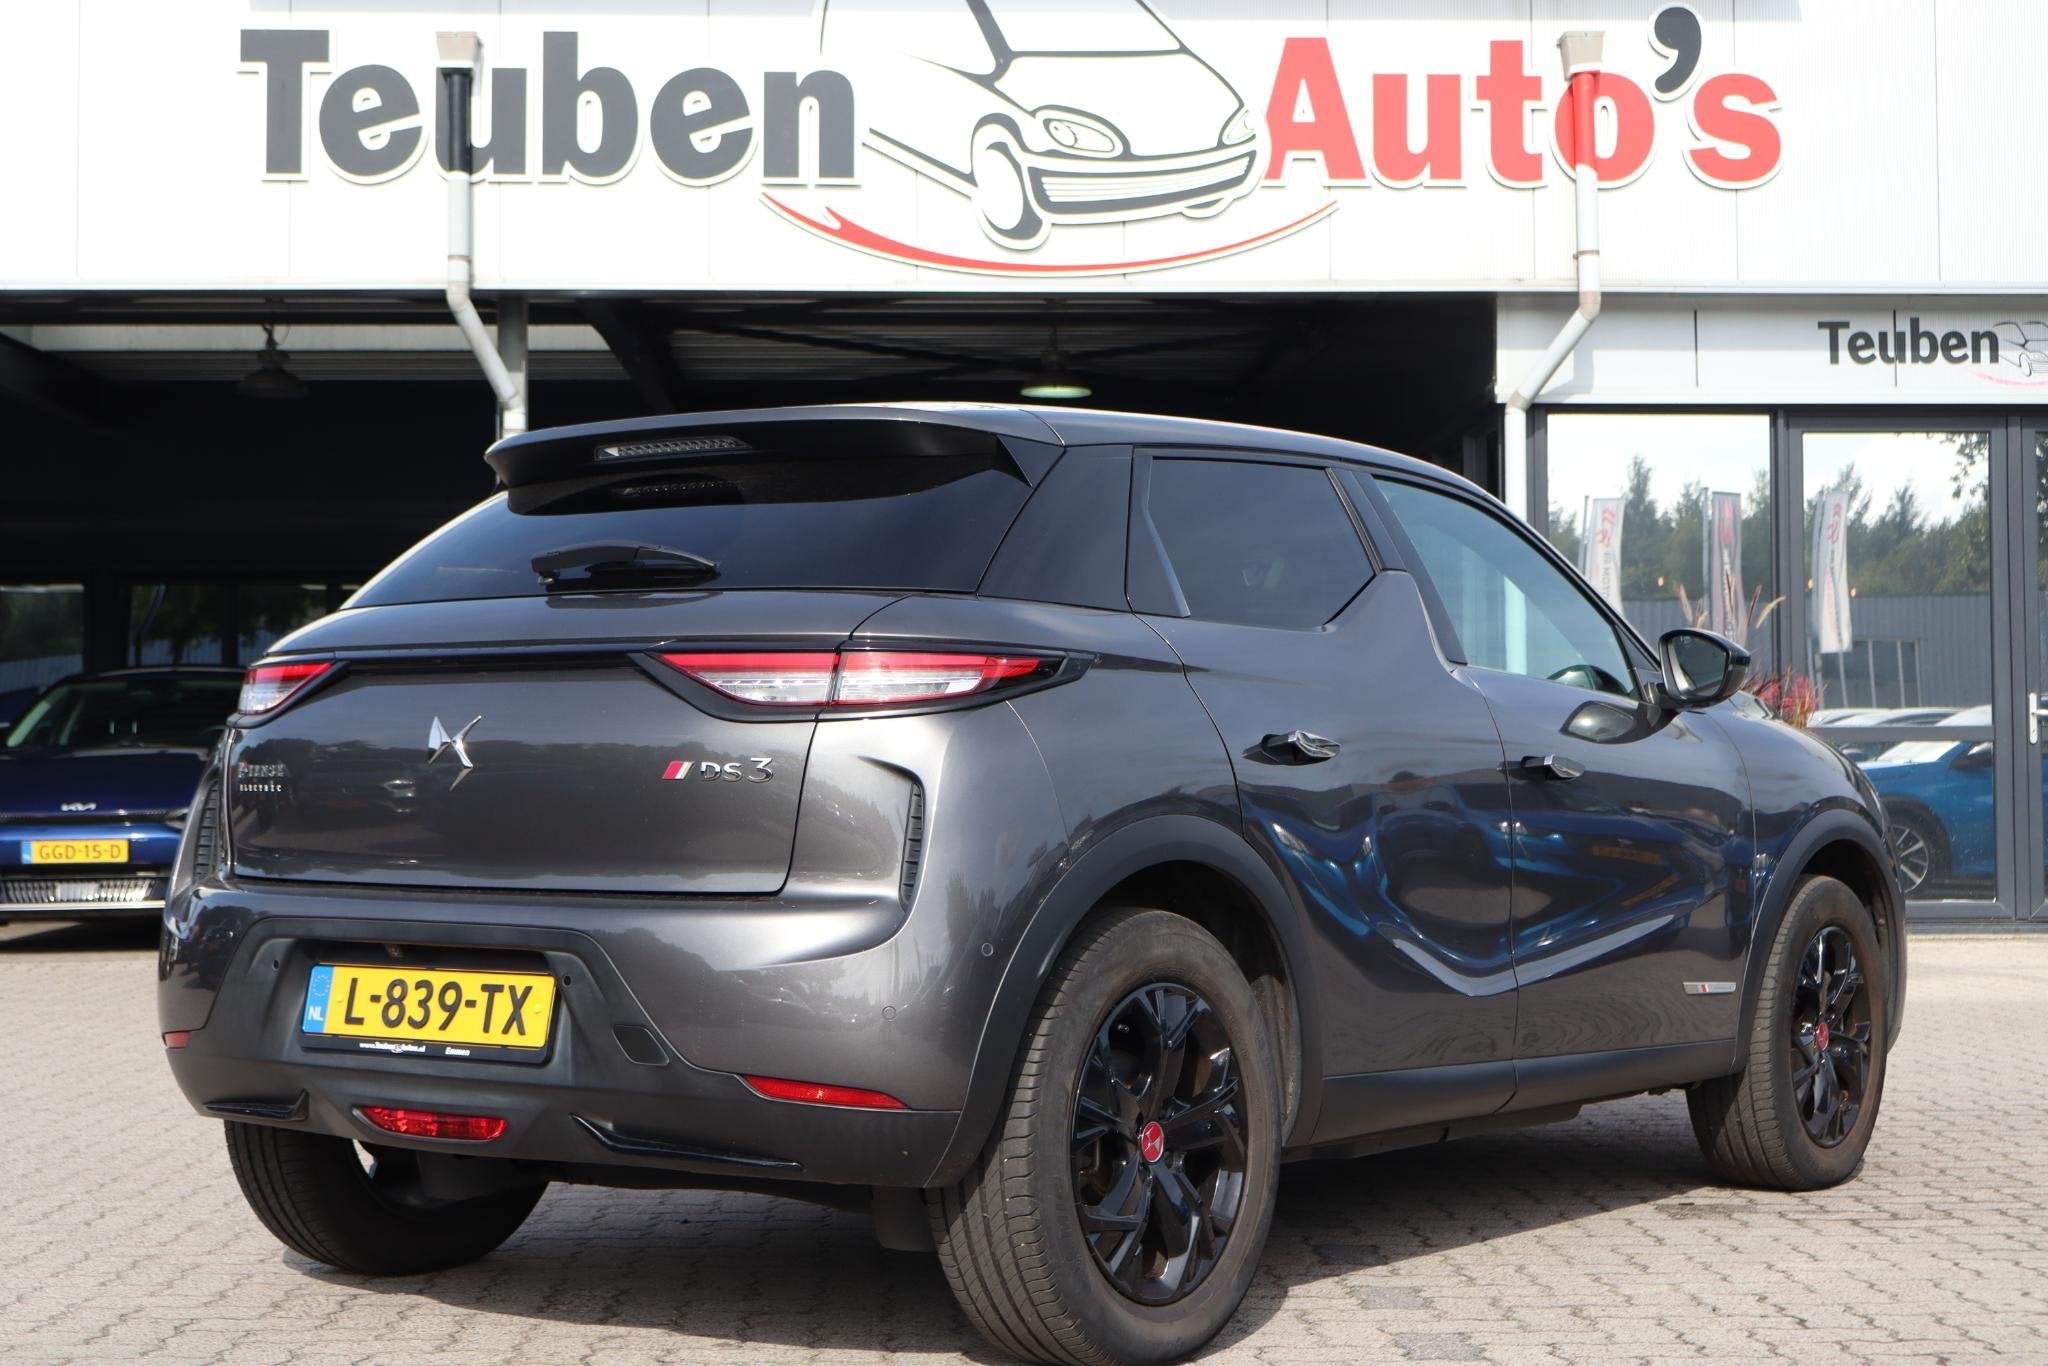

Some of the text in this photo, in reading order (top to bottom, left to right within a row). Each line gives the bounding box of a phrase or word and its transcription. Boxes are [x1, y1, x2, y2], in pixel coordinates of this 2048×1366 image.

[240, 6, 1782, 183] Teuben Auto's
[1817, 317, 1999, 365] Teuben
[700, 757, 774, 784] DS 3
[40, 844, 121, 860] GGD-15-D
[307, 977, 534, 1036] NL L-839-TX
